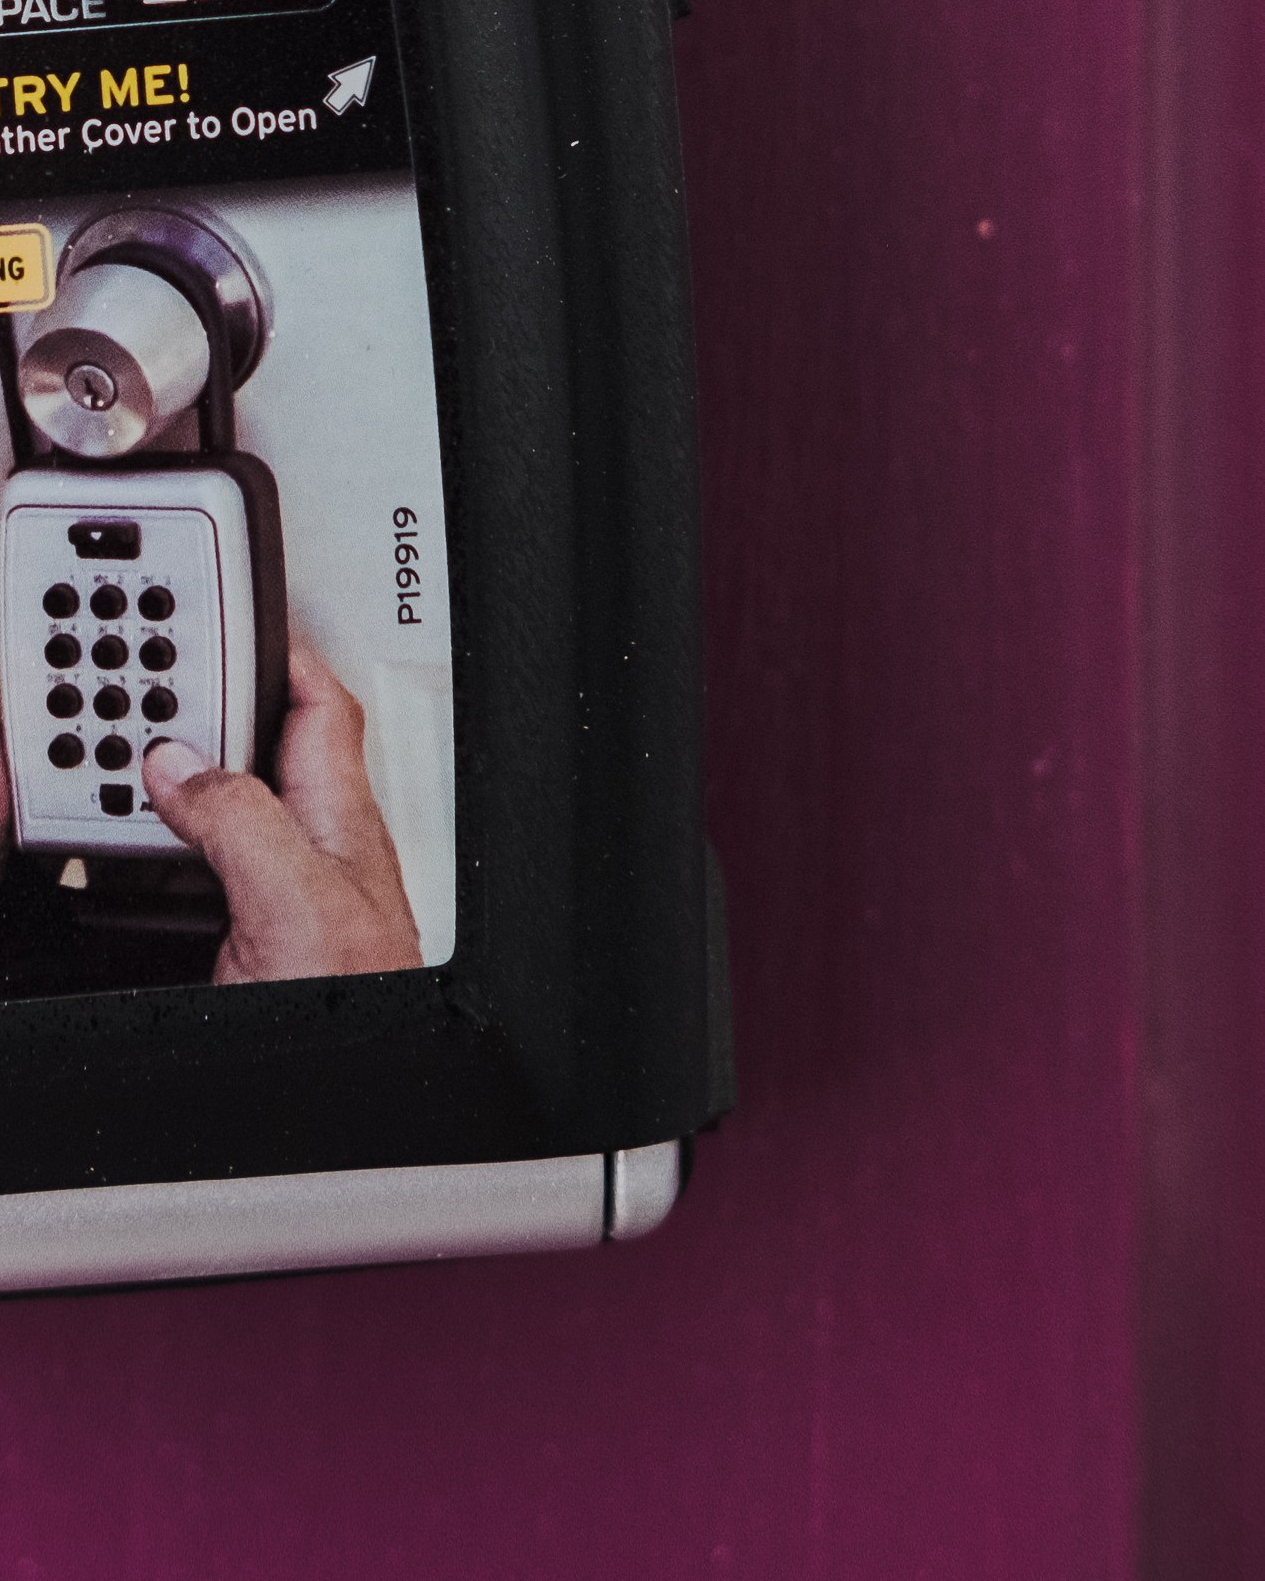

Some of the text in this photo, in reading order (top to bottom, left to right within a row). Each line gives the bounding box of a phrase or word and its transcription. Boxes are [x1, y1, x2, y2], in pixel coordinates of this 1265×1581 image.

[101, 63, 190, 109] ME!
[81, 117, 175, 149] Cover
[186, 113, 221, 140] to
[231, 106, 318, 145] Open
[392, 506, 422, 625] P19919
